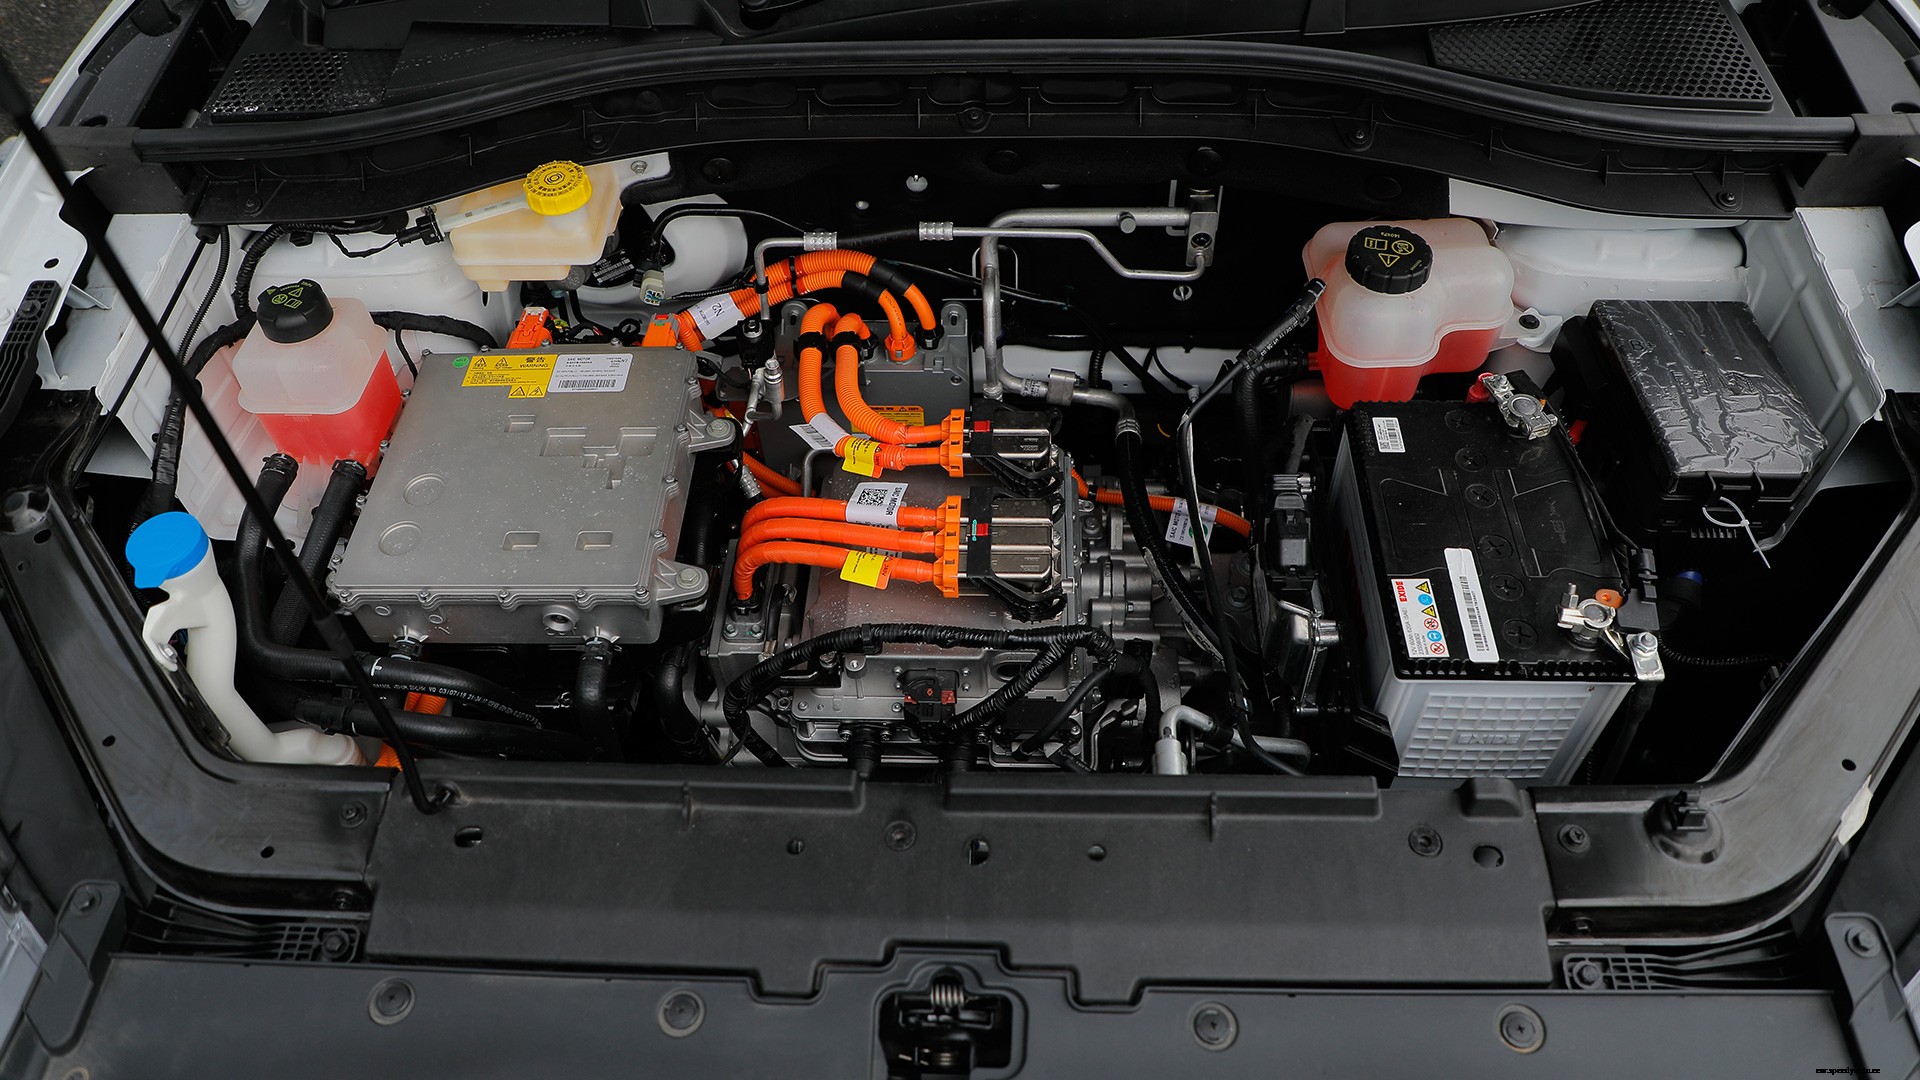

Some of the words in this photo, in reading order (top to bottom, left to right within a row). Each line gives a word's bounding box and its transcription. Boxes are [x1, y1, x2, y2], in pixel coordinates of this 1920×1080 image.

[1169, 526, 1178, 539] SAIC
[1395, 581, 1408, 603] EXIDE
[1457, 734, 1521, 744] EXIDE
